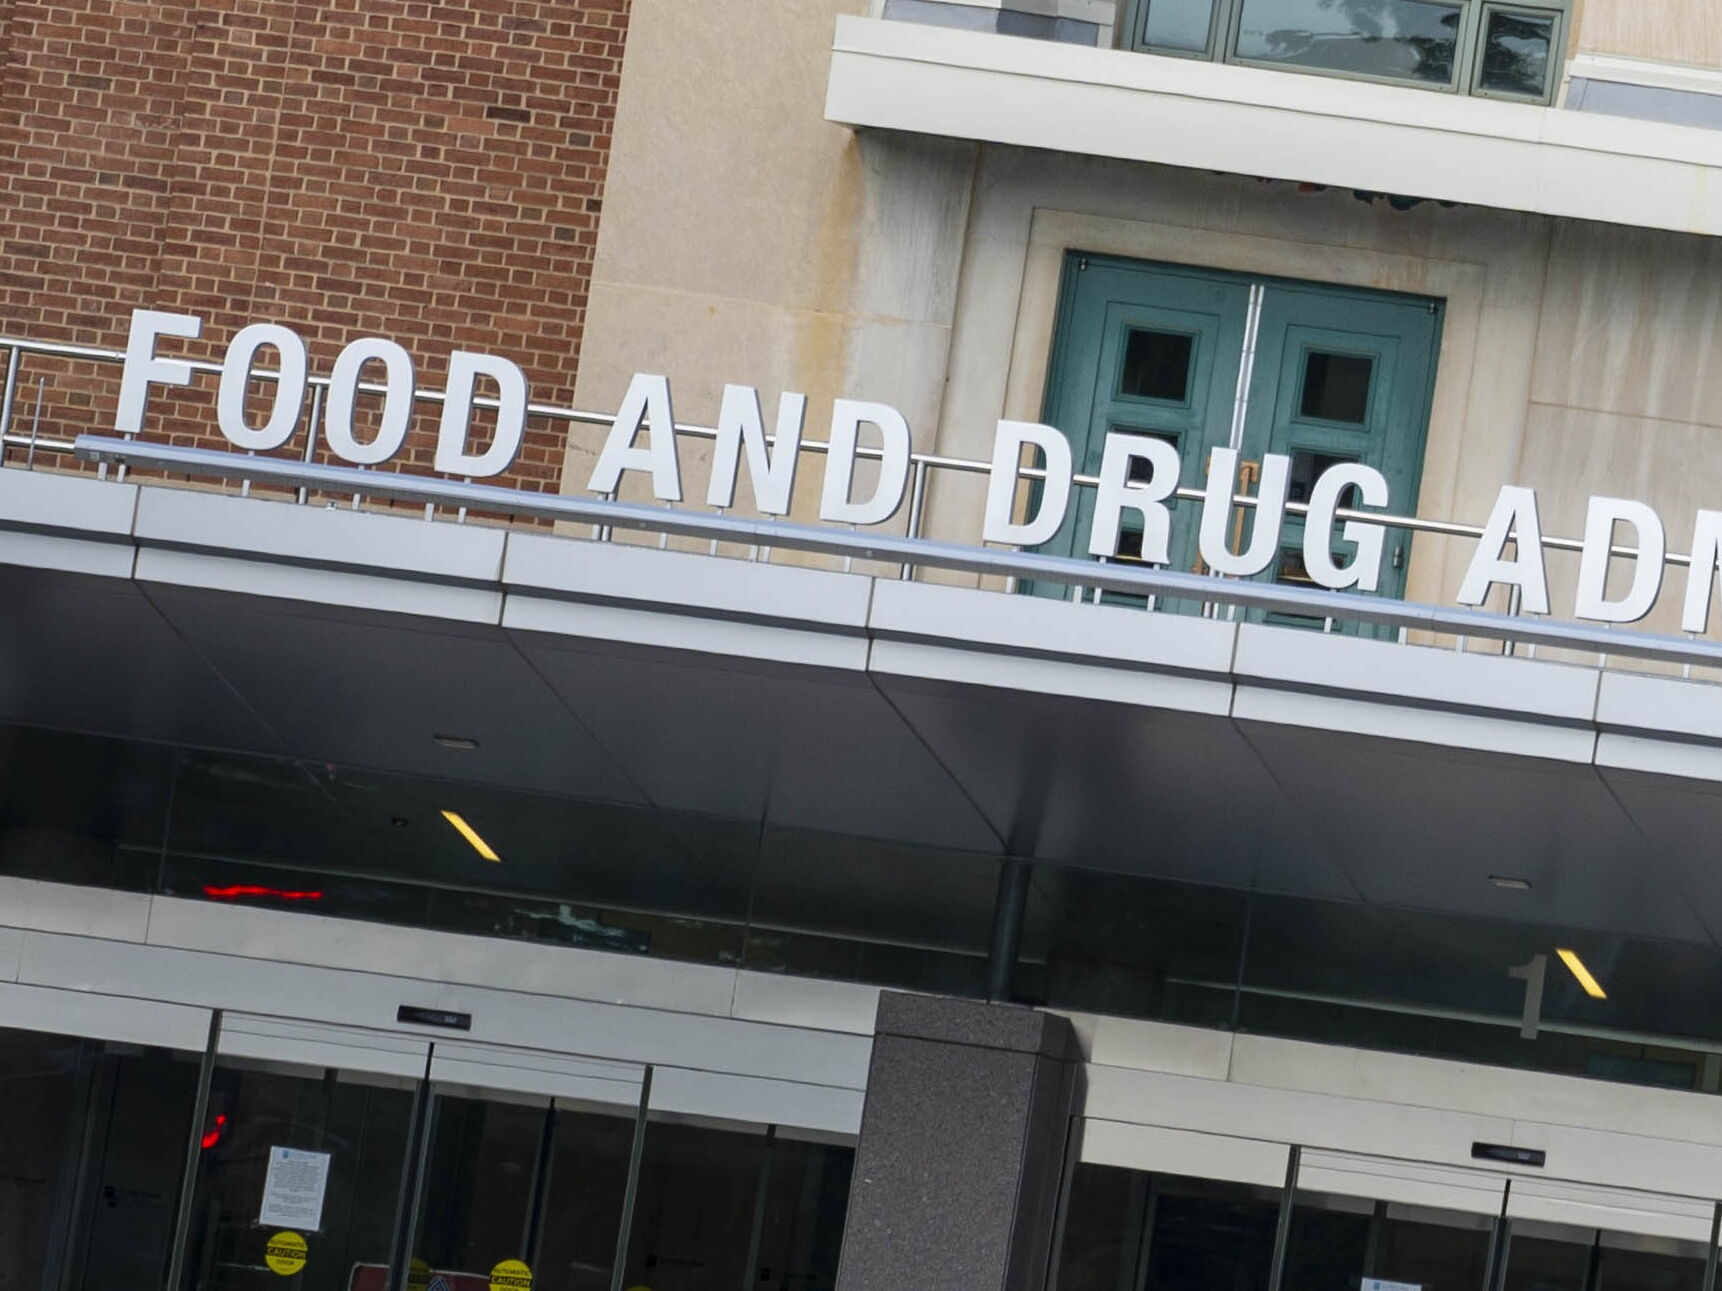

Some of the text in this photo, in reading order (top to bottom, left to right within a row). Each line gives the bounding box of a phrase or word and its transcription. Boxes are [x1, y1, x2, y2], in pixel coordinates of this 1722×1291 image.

[114, 308, 530, 478] FOOD
[587, 372, 913, 526] AND
[981, 419, 1390, 591] DRUG
[1509, 954, 1548, 1040] 1
[267, 1247, 306, 1258] CAUTION
[492, 1276, 530, 1288] CAUTION
